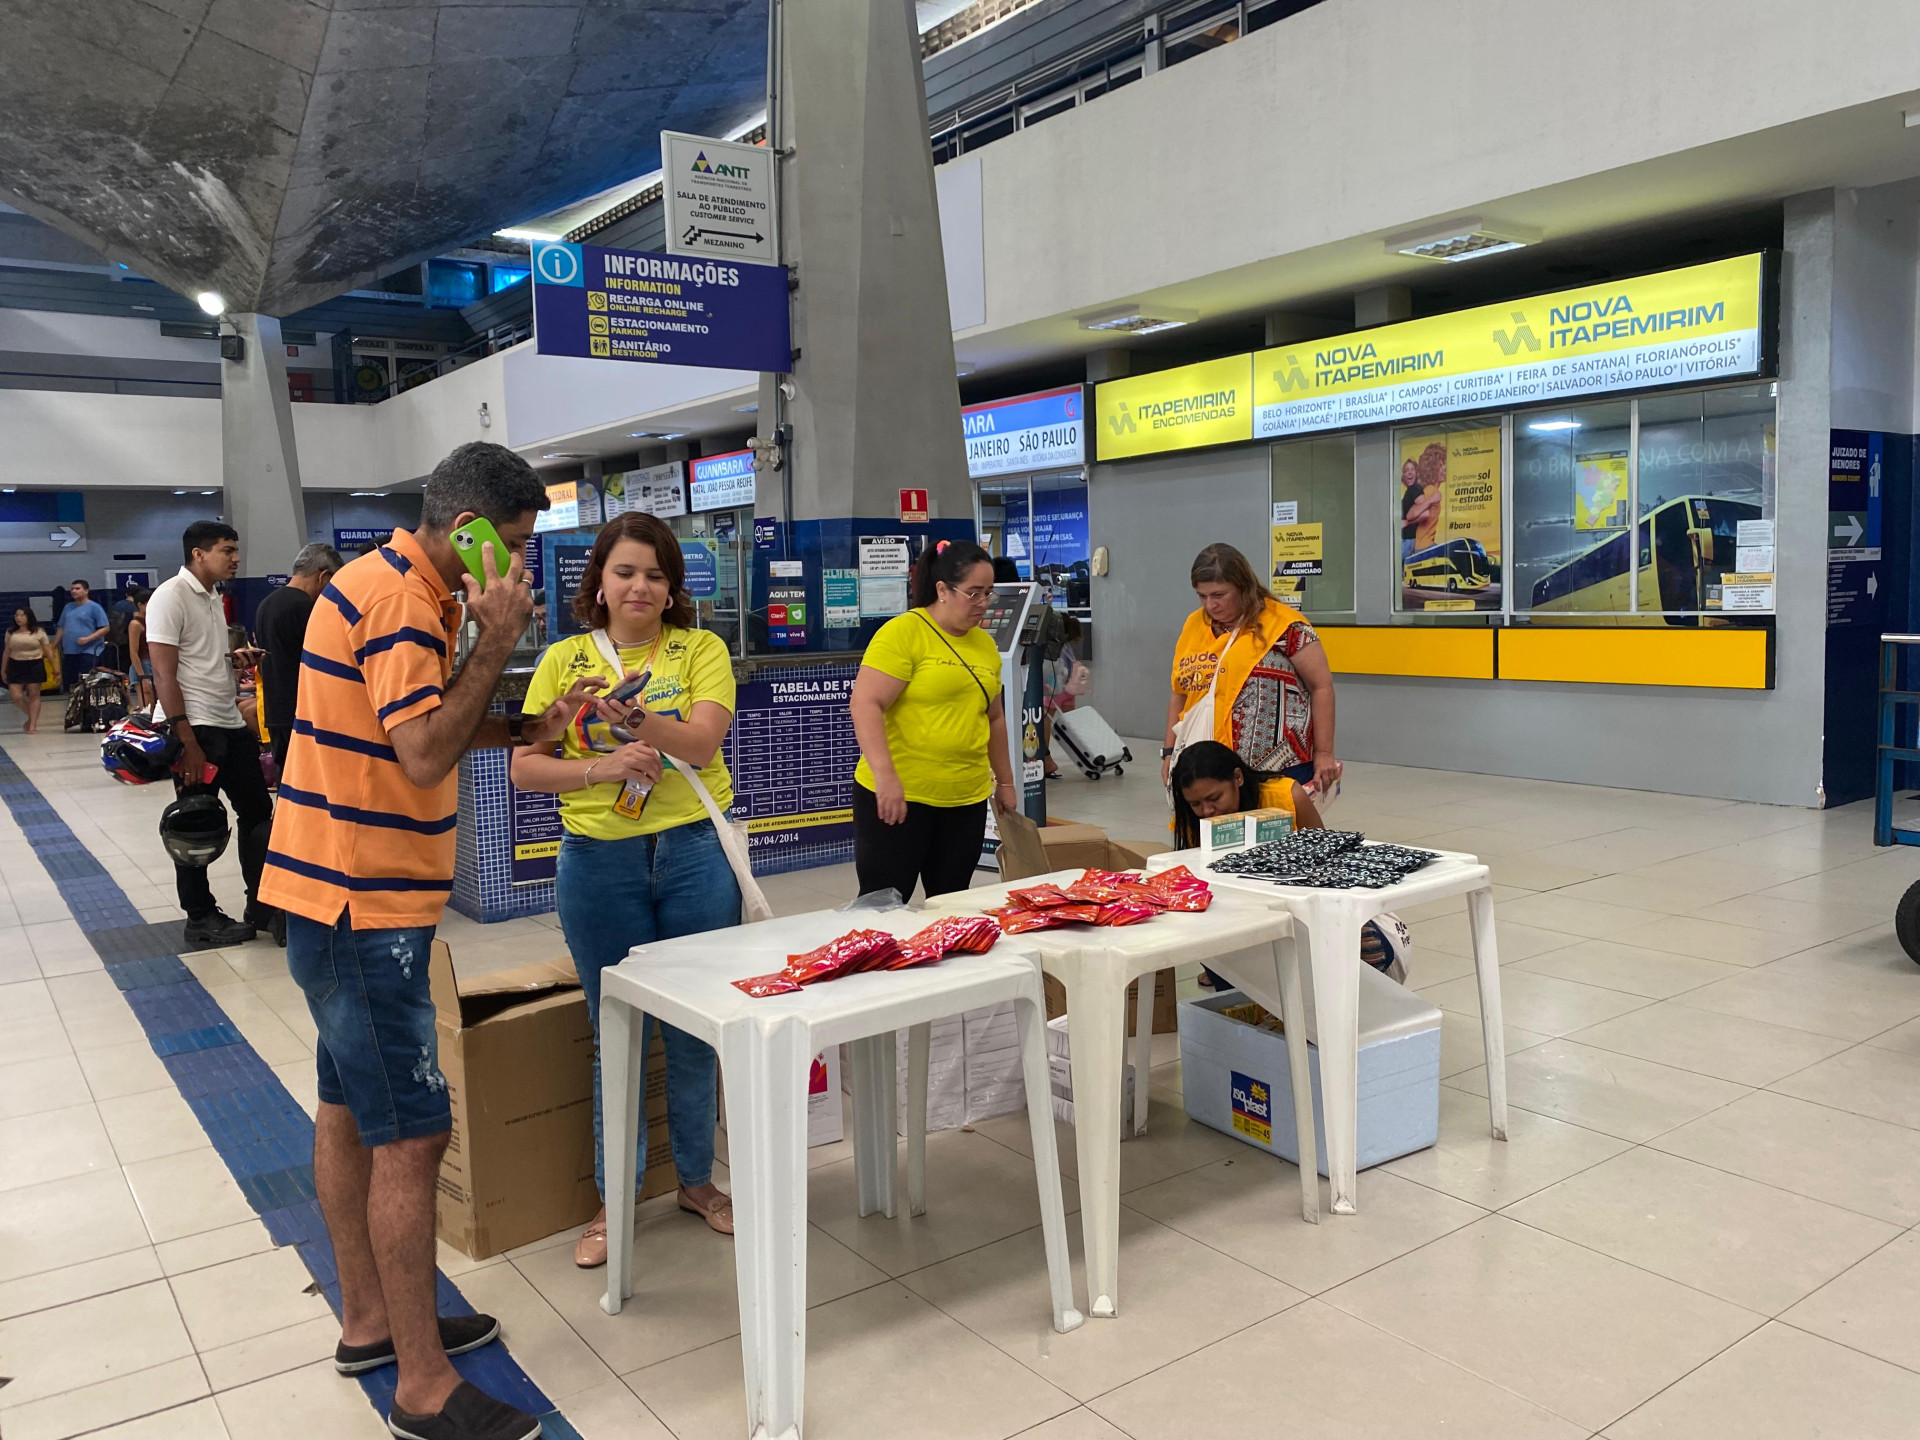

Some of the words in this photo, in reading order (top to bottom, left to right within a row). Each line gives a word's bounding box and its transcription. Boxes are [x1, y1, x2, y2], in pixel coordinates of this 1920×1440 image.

[715, 164, 750, 179] ANTT
[677, 191, 696, 200] SALA
[699, 194, 708, 202] DE
[711, 196, 766, 209] ATENDIMENTO
[690, 211, 726, 221] CUSTOMER
[729, 216, 754, 224] SERVICE
[704, 239, 744, 249] MEZANINO
[604, 254, 740, 288] INFORMAÇÕES
[605, 277, 681, 296] INFORMATION
[609, 294, 662, 309] RECARGA
[664, 298, 704, 312] ONLINE
[609, 304, 641, 314] ONLINE
[643, 307, 687, 317] RECHARGE
[1550, 295, 1633, 326] NOVA
[610, 317, 709, 335] ESTACIONAMENTO
[611, 326, 648, 336] PARKING
[1549, 302, 1724, 349] ITAPEMIRIM
[612, 339, 671, 353] SANITÁRIO
[612, 349, 658, 359] RESTROOM
[1316, 342, 1377, 368] NOVA
[1316, 350, 1443, 388] ITAPEMIRIM
[1263, 409, 1281, 419] BELO
[1517, 368, 1547, 381] FEIRA
[1553, 364, 1566, 375] DE
[1572, 356, 1626, 374] SANTANA
[1338, 406, 1384, 421] PETROLINA
[1390, 402, 1419, 414] PORTO
[1421, 395, 1455, 409] ALEGRE
[1461, 392, 1478, 403] RIO
[1480, 391, 1492, 401] DE
[1546, 375, 1602, 392] SALVADOR
[1610, 370, 1633, 383] SÃO
[1139, 389, 1235, 420] ITAPEMIRIM
[1153, 407, 1235, 429] ENCOMENDAS
[969, 438, 1010, 459] JANEIRO
[1020, 431, 1039, 452] SÃO
[1042, 427, 1076, 448] PAULO
[1832, 447, 1858, 457] JUIZADO
[1859, 449, 1867, 458] DE
[697, 459, 744, 480] GUANABARA
[1831, 459, 1860, 470] MENORES
[1478, 469, 1490, 480] sol
[693, 484, 706, 494] NATAL
[708, 481, 717, 493] JOÃO
[719, 480, 735, 491] PESSOA
[737, 476, 752, 488] RECIFE
[1455, 483, 1492, 496] amarelo
[1459, 493, 1492, 503] estradas
[1449, 522, 1470, 530] #bora
[1283, 567, 1321, 575] CREDENCIADO
[771, 682, 820, 694] TABELA
[823, 680, 839, 691] DE
[773, 692, 846, 703] ESTACIONAMENTO
[538, 825, 558, 833] FRAÇÃO
[771, 818, 805, 826] ATENDIMENTO
[749, 833, 798, 847] 28/04/2014
[1263, 1129, 1270, 1140] 45
